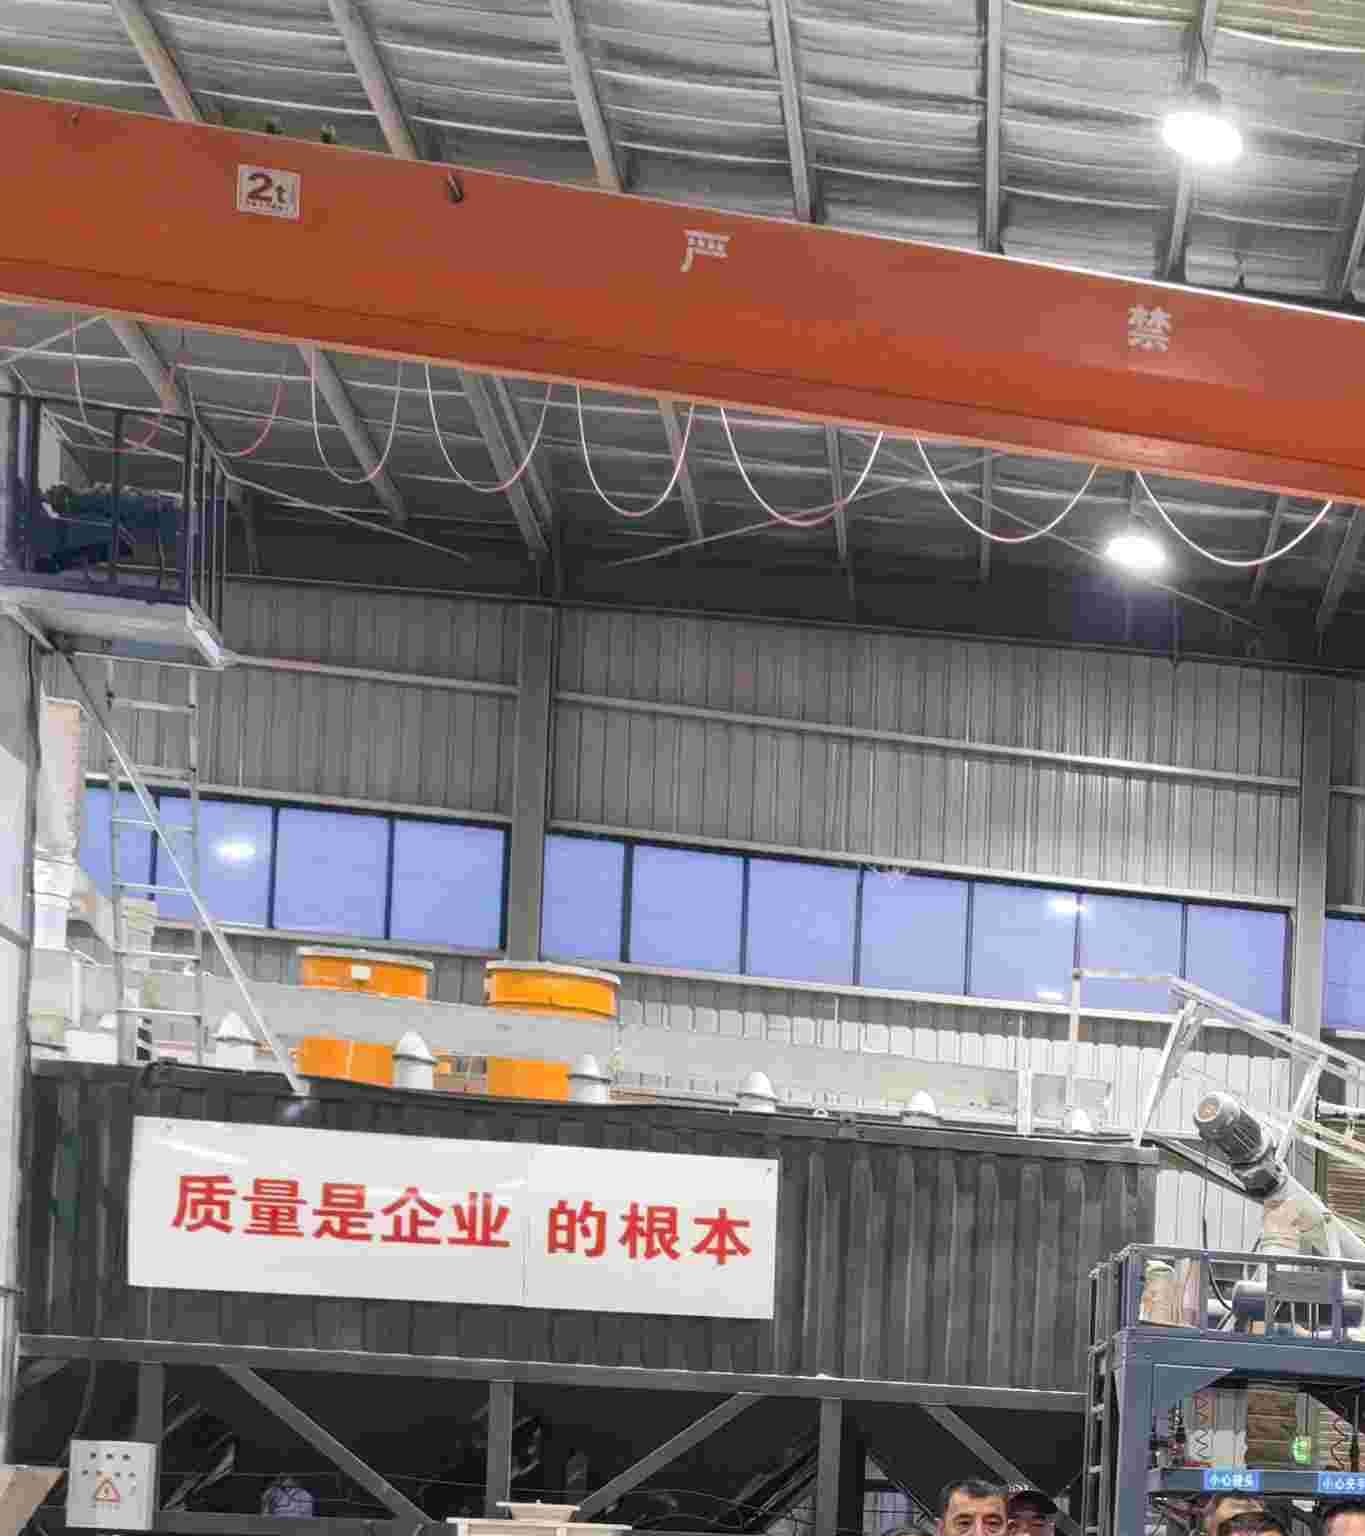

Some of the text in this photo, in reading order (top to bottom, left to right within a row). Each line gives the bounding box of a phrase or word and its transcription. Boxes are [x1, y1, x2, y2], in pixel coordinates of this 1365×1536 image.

[247, 173, 288, 204] 2t
[680, 229, 729, 272] 严
[1127, 306, 1172, 352] 禁
[172, 1174, 751, 1265] 质量是企业的根本
